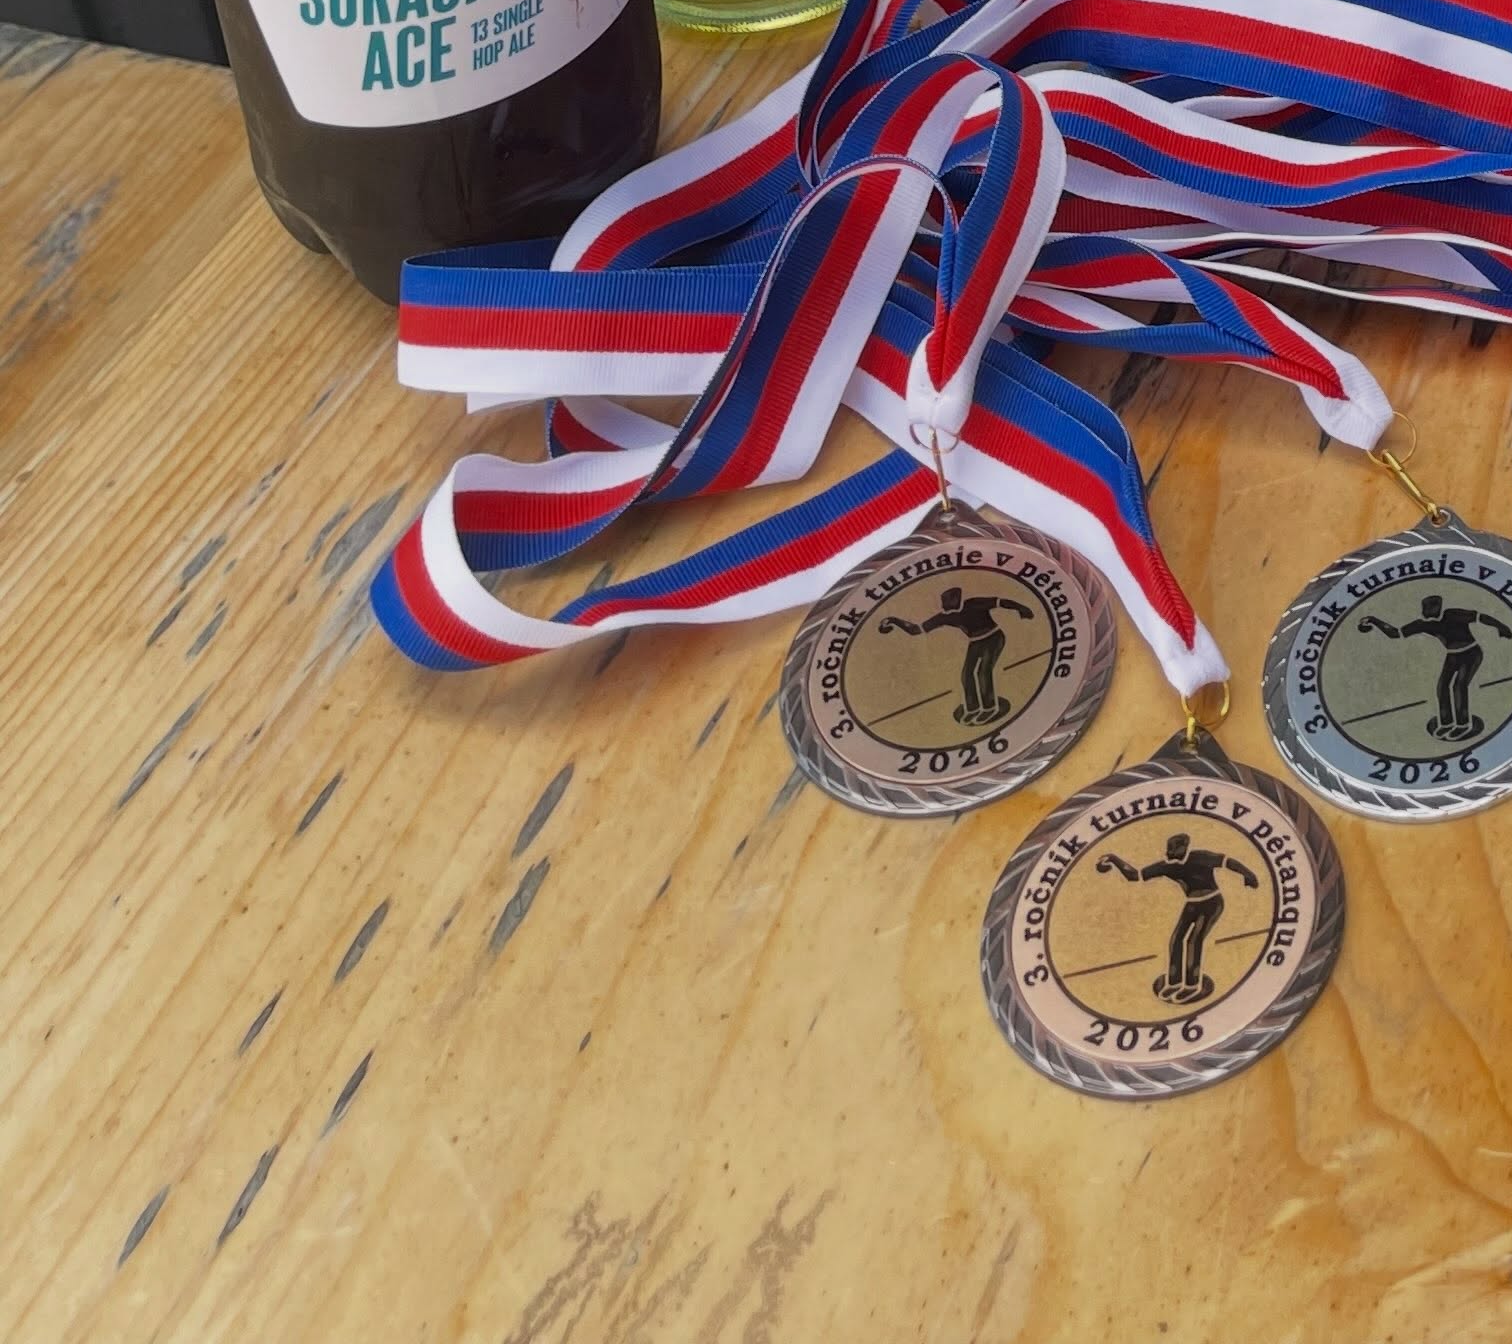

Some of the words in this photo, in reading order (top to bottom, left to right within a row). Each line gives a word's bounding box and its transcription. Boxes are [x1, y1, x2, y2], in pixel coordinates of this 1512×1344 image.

[361, 15, 457, 92] ACE
[471, 19, 490, 44] 13
[472, 42, 504, 72] HOP
[508, 23, 536, 59] ALE
[829, 709, 855, 740] 3.
[864, 545, 983, 602] turnaje
[996, 552, 1014, 567] v
[1016, 563, 1079, 680] pétanque
[1304, 703, 1329, 734] 3.
[1346, 554, 1466, 599] turnaje
[1478, 567, 1497, 581] v
[897, 732, 1010, 774] 2026
[1368, 750, 1480, 785] 2026
[1024, 952, 1050, 988] 3.
[1089, 786, 1220, 834] turnaje
[1231, 802, 1252, 820] v
[1249, 819, 1301, 968] pétanque
[1083, 1014, 1204, 1053] 2026
